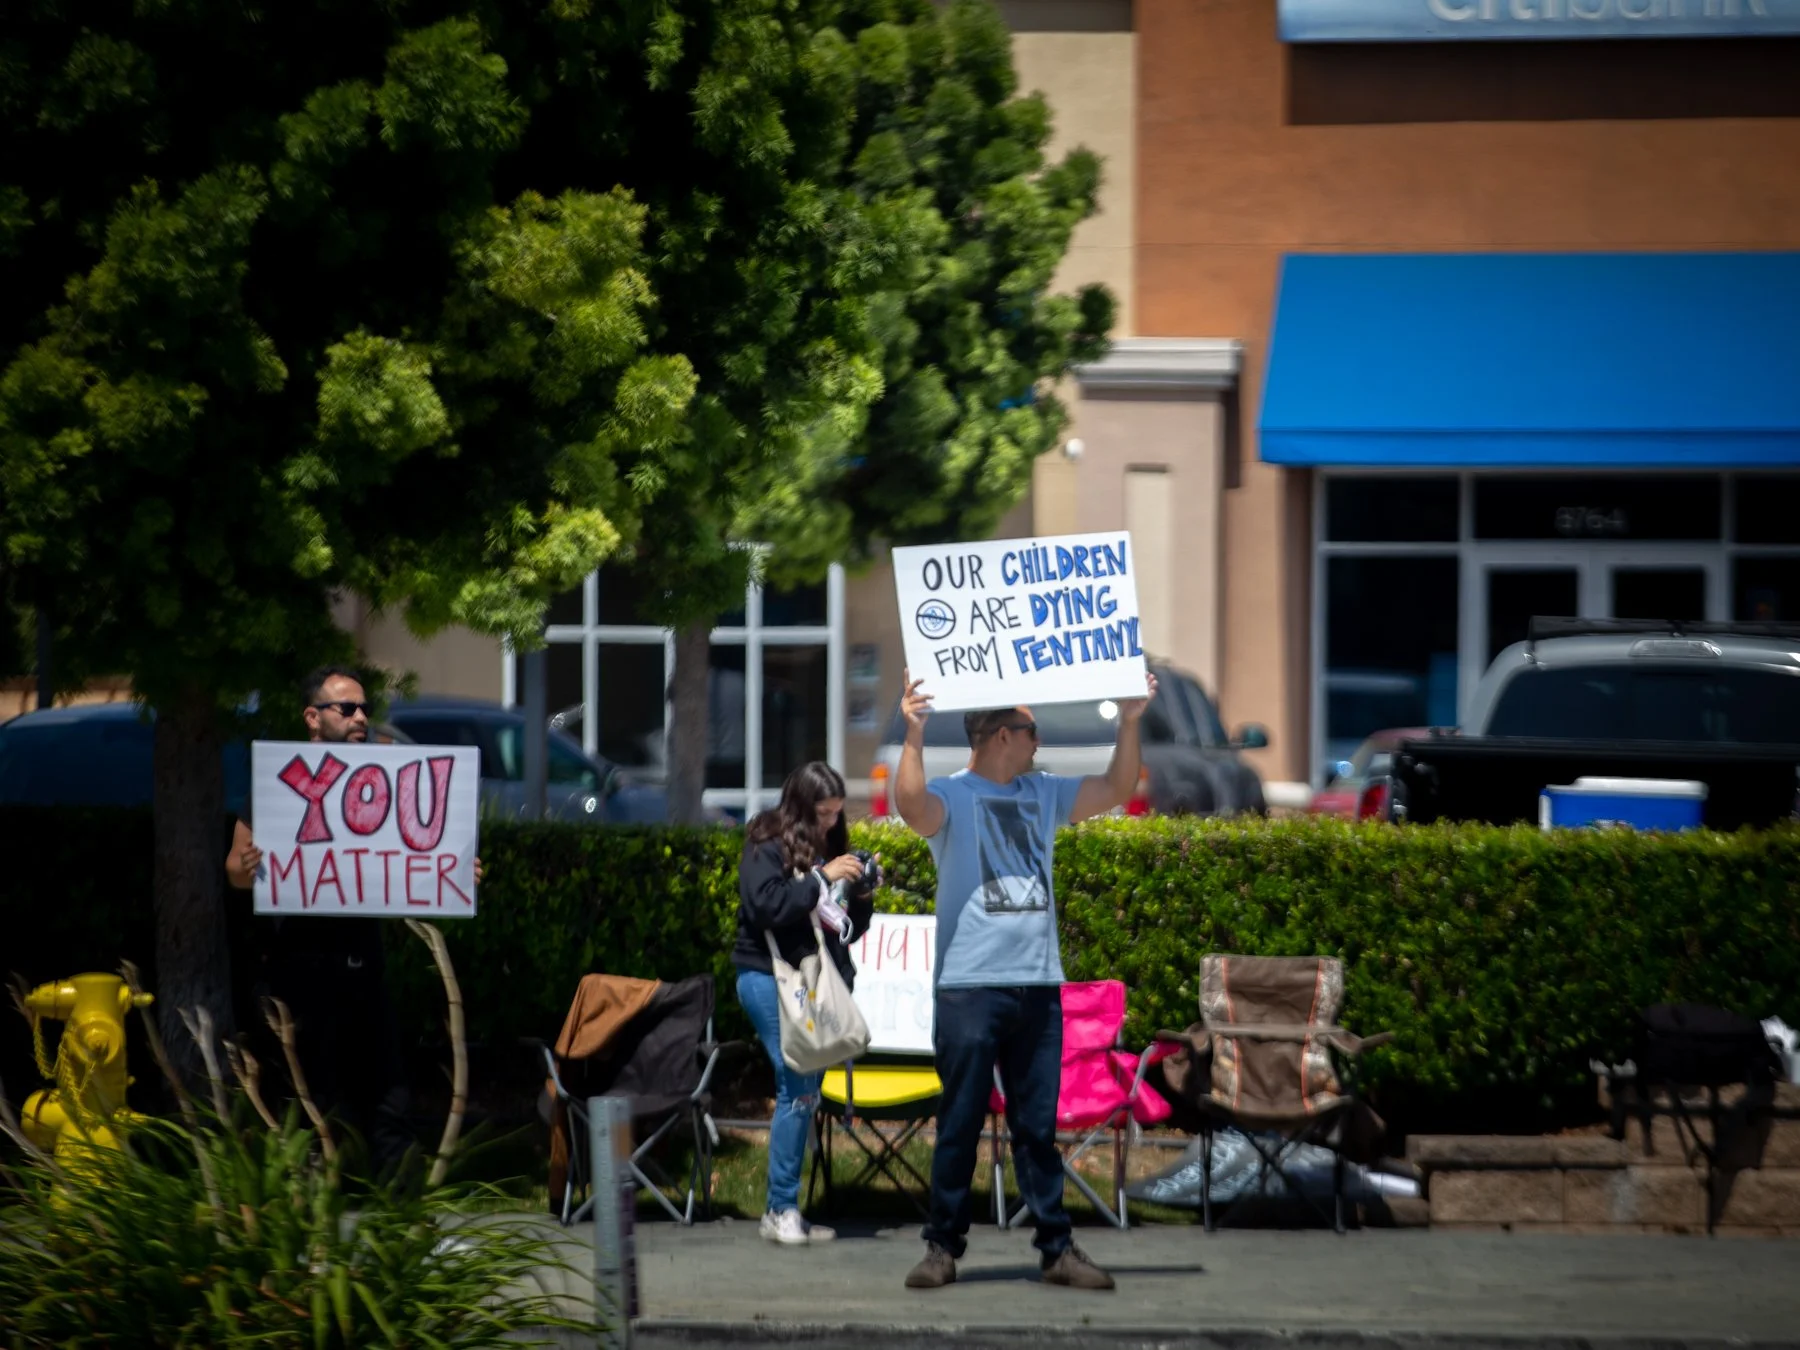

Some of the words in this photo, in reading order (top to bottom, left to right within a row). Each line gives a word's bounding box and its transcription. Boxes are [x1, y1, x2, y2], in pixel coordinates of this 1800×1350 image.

[922, 554, 985, 591] OUR
[970, 596, 1021, 635] ARE
[934, 636, 1003, 680] FROM
[1012, 616, 1143, 674] FENTANYL
[277, 751, 455, 852] YOU
[269, 844, 472, 909] MATTER
